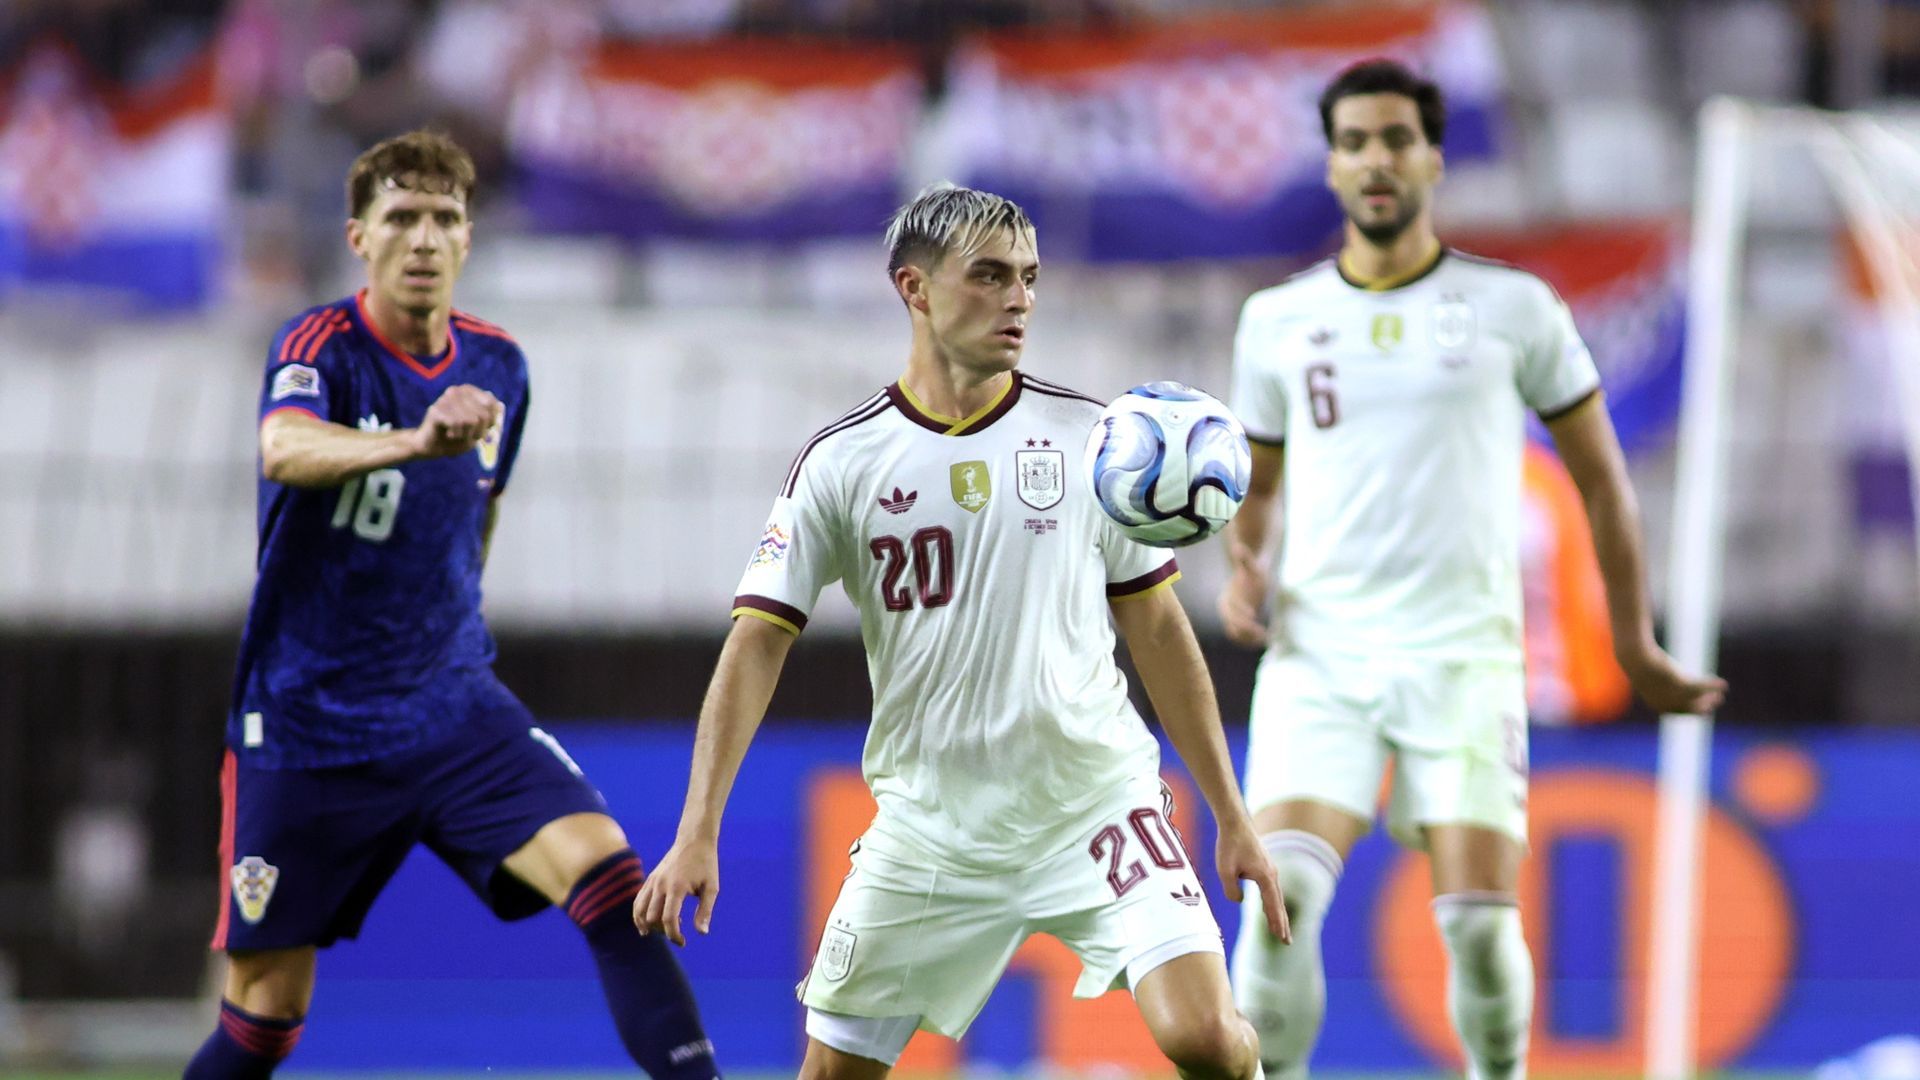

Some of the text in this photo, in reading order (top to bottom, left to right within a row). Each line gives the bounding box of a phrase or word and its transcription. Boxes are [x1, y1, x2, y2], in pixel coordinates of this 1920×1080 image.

[1305, 363, 1339, 428] 6
[331, 469, 405, 541] 18
[870, 525, 954, 612] 20
[1089, 807, 1185, 898] 20
